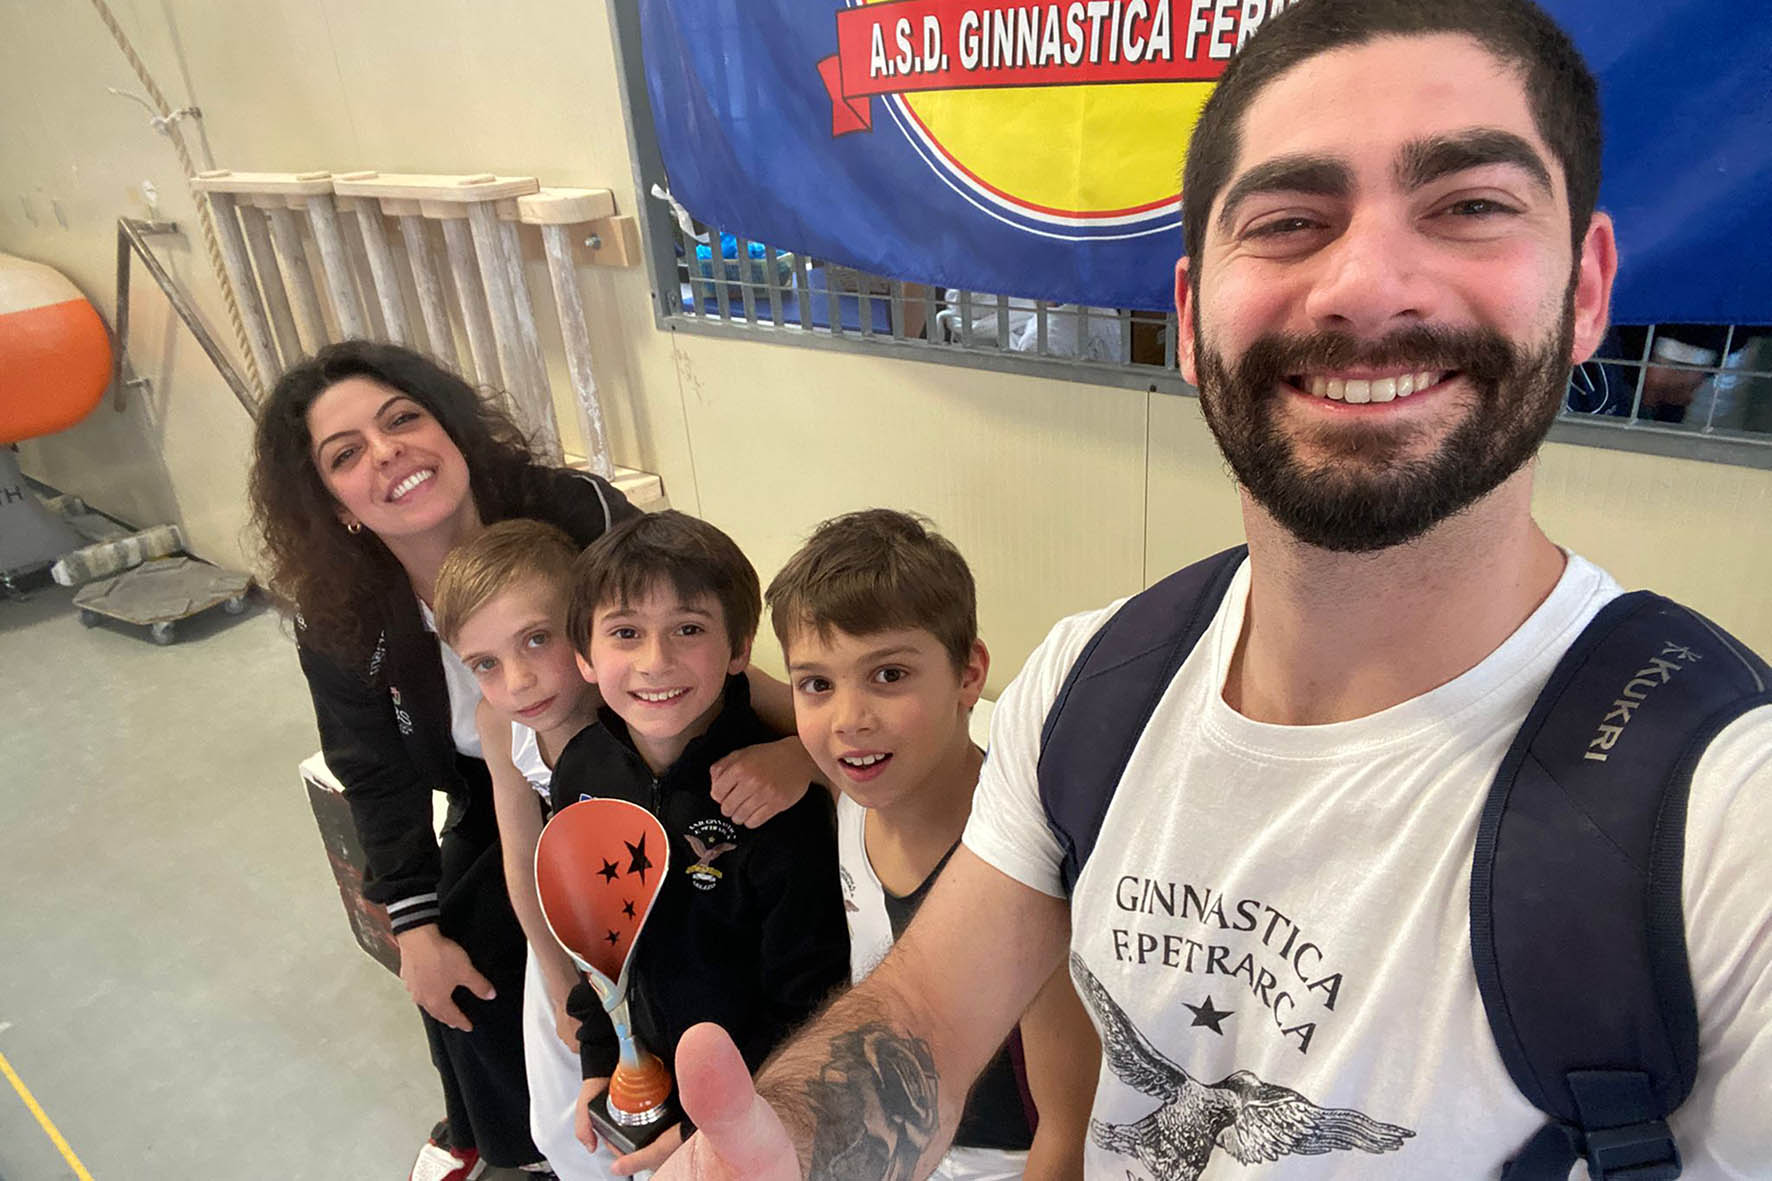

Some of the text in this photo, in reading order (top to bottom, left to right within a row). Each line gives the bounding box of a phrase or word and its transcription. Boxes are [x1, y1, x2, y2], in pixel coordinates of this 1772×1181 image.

[870, 11, 949, 78] A.S.D.
[958, 0, 1173, 70] GINNASTICA
[1583, 656, 1684, 762] KUKRI
[1115, 874, 1344, 1012] GINNASTICA
